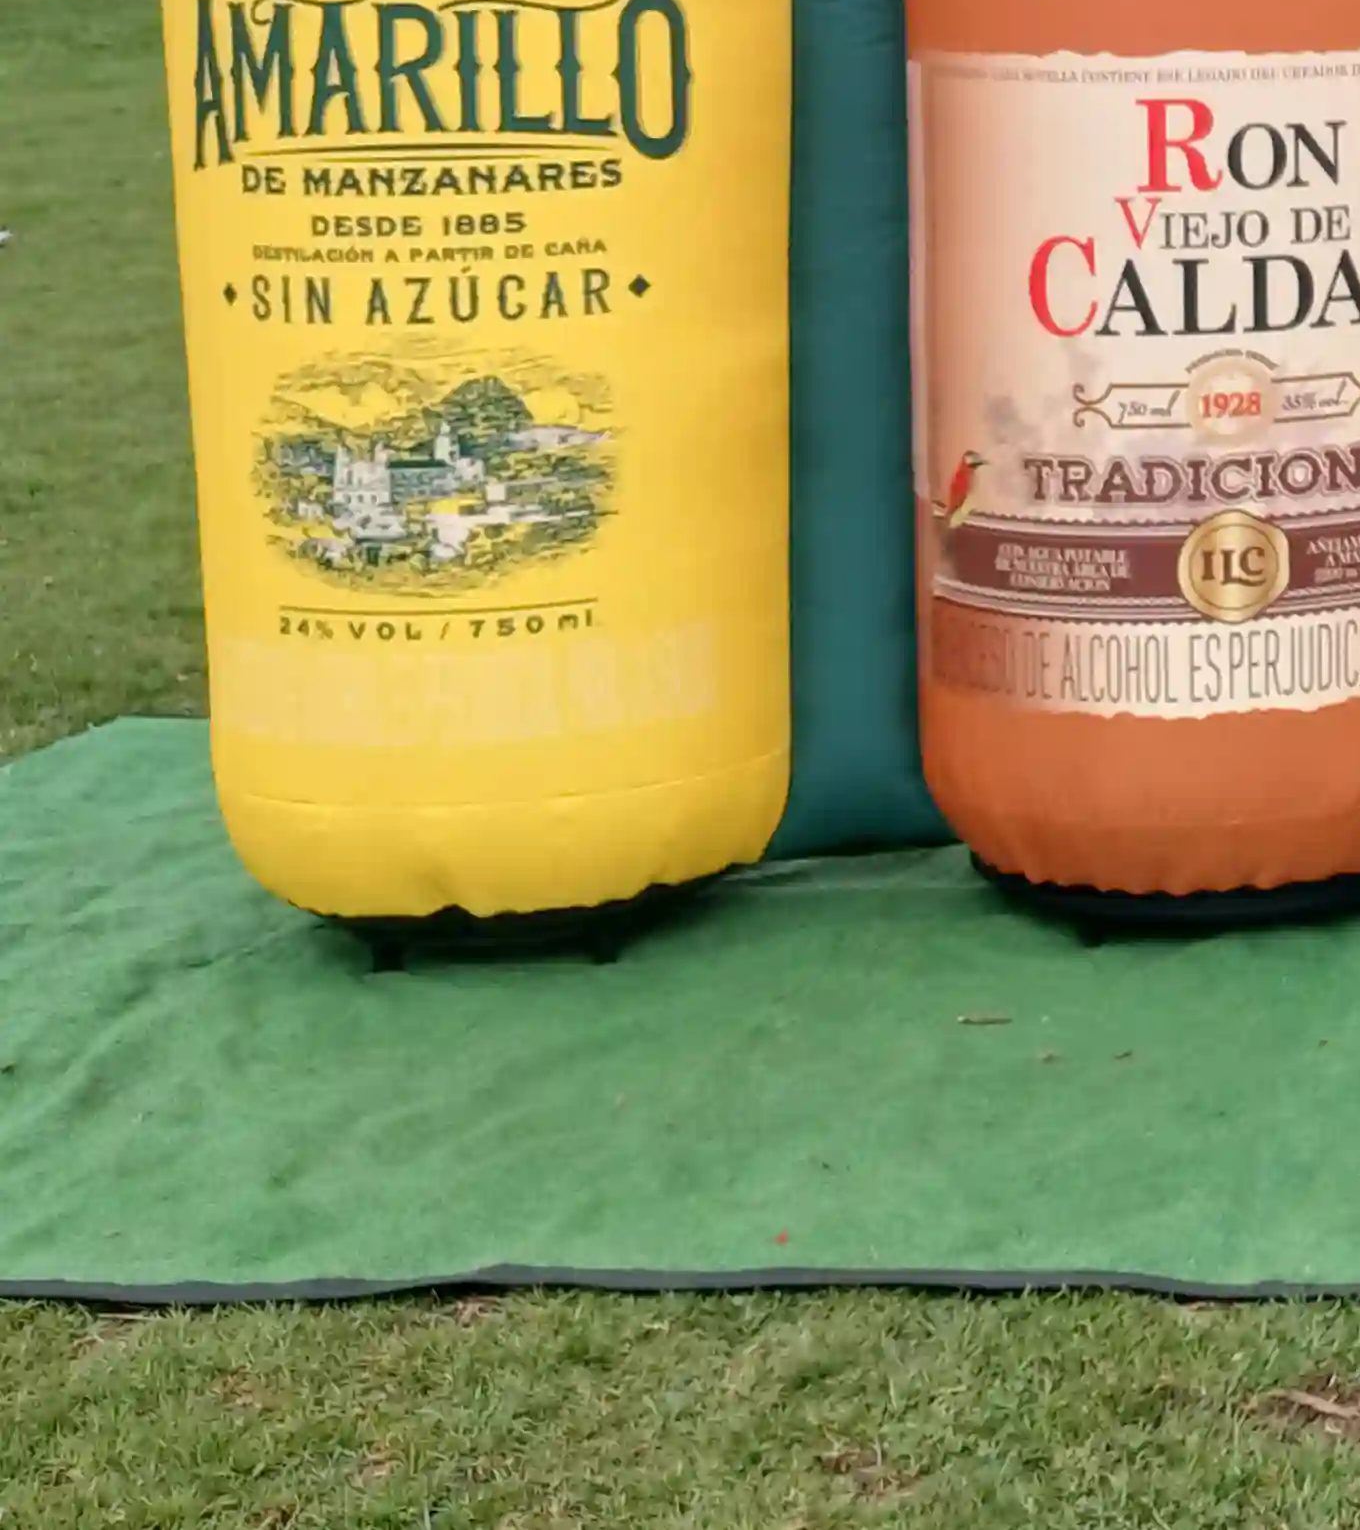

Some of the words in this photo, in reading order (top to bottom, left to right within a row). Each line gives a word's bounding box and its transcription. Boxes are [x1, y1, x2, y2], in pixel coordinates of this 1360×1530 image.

[242, 167, 287, 195] DE
[302, 160, 624, 197] MANZANARES
[311, 215, 422, 237] DESDE
[443, 211, 527, 237] 1885
[1291, 205, 1352, 246] DE
[252, 244, 374, 263] DESTILACIÓN
[385, 248, 400, 263] A
[409, 246, 494, 263] PARTIR
[504, 244, 534, 260] DE
[252, 273, 333, 325] SIN
[365, 265, 612, 325] AZÚCAR
[1199, 391, 1262, 419] 1928
[1200, 545, 1267, 587] ILC
[278, 615, 334, 642] 24%
[348, 618, 422, 642] VOL
[1022, 631, 1053, 699] DE
[1060, 633, 1178, 704] ALCOHOL
[1189, 632, 1223, 704] ES
